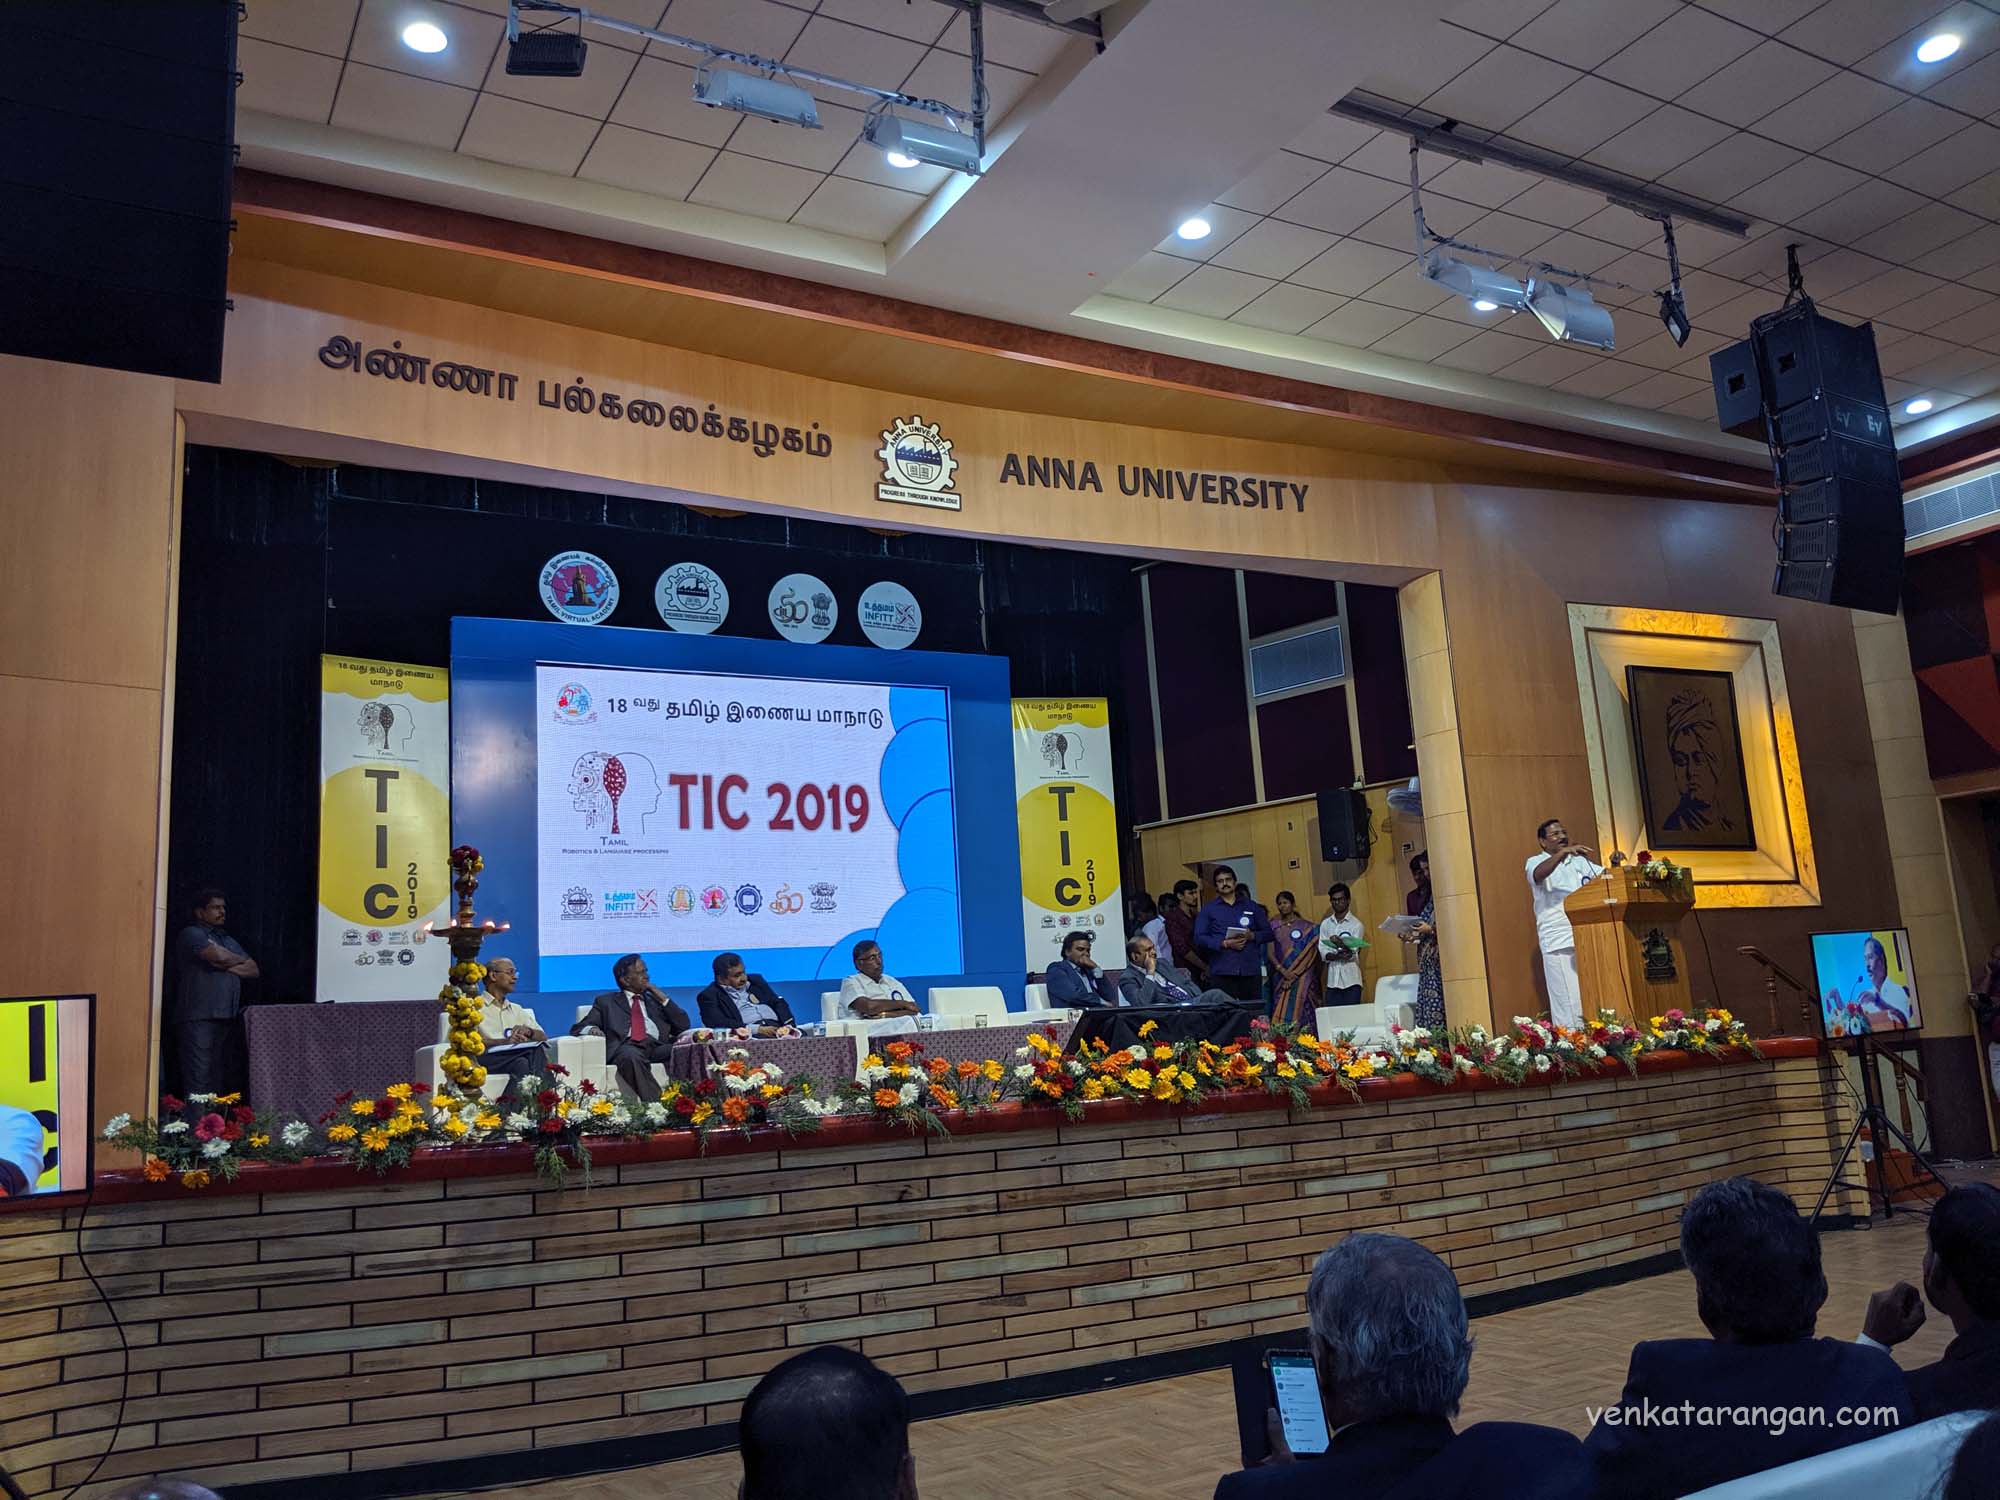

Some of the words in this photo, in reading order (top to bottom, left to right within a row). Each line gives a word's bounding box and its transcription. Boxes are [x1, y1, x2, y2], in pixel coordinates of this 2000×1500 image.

[319, 334, 518, 401] அண்ணா
[538, 376, 833, 458] பல்கலைக்கழகம்
[889, 427, 908, 449] ANNA
[908, 425, 949, 457] UNIVERSITY
[1000, 452, 1103, 493] ANNA
[1117, 464, 1311, 513] UNIVERSITY
[545, 593, 561, 615] TAMIL
[560, 611, 591, 623] VIRTUAL
[591, 597, 615, 622] ACADEMY
[865, 611, 894, 623] INFITT
[370, 679, 404, 690] மாநாடு
[607, 697, 628, 714] 18
[632, 696, 660, 712] வது
[665, 698, 720, 723] தமிழ்
[726, 702, 812, 723] இணைய
[817, 707, 884, 730] மாநாடு
[668, 773, 750, 831] TIC
[766, 782, 870, 833] 2019
[407, 862, 418, 919] 2019
[1086, 859, 1097, 906] 2019
[605, 902, 636, 912] INFITT
